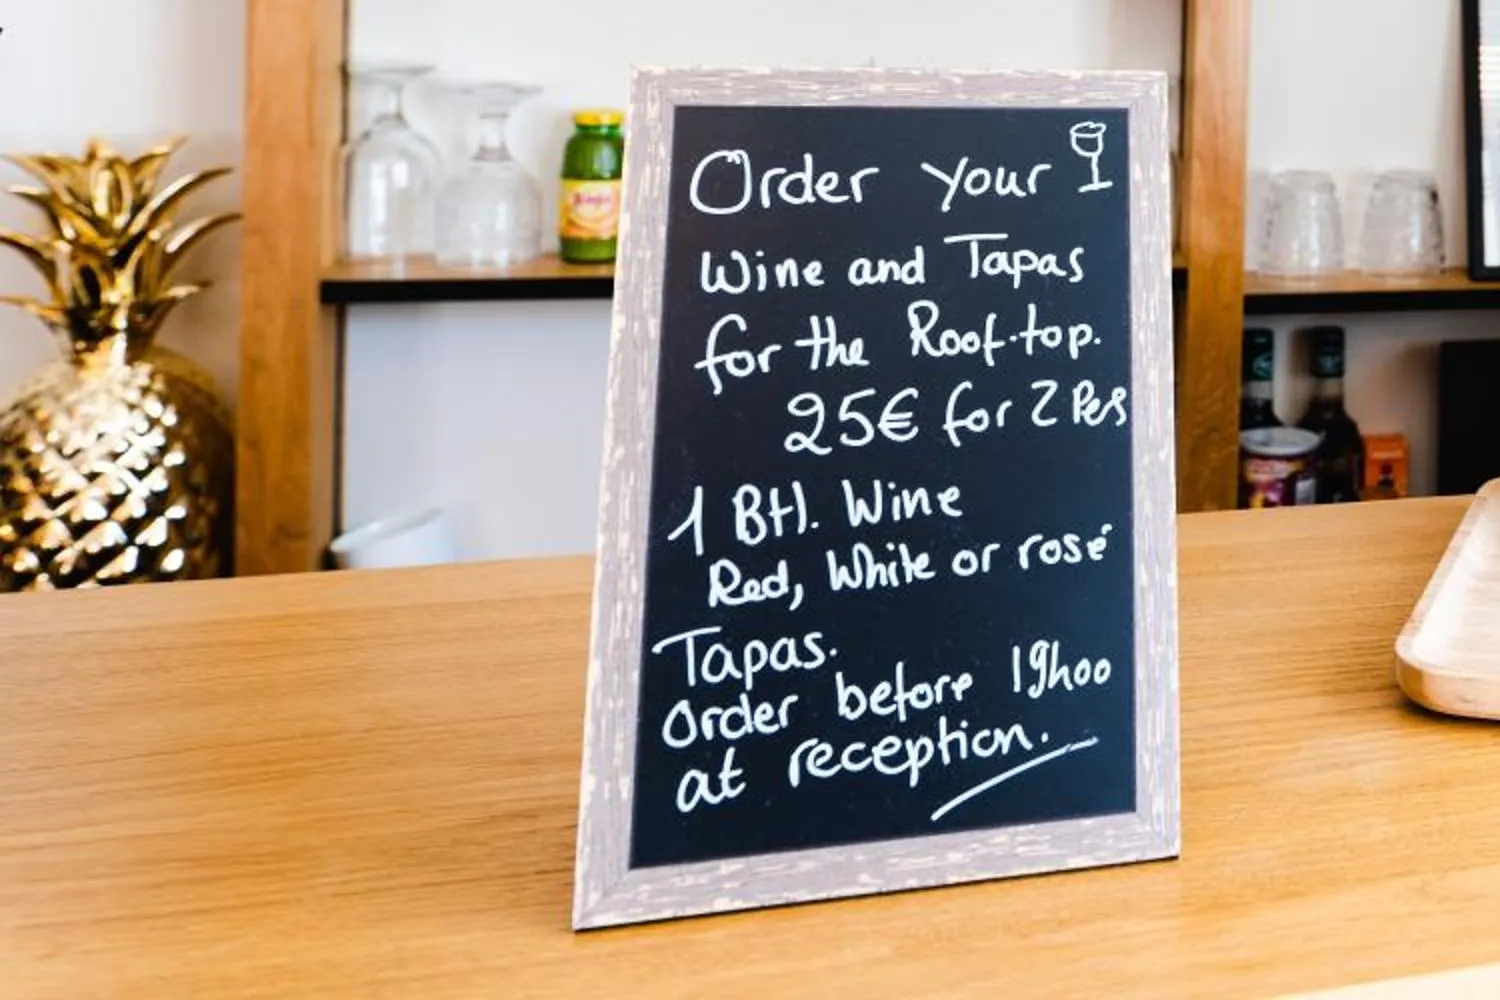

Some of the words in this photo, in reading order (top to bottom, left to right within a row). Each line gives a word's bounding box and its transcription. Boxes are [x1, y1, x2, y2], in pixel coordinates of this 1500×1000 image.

[689, 149, 880, 215] Order
[920, 156, 1052, 213] your
[700, 249, 825, 295] Wine
[847, 245, 926, 287] and
[943, 232, 1085, 289] Tapas
[693, 313, 782, 396] for
[794, 315, 870, 371] the
[783, 387, 919, 456] 25€
[942, 380, 1013, 448] for
[1031, 379, 1059, 427] 2
[667, 485, 704, 556] 1
[841, 479, 963, 527] Wine
[708, 558, 804, 611] Red,
[826, 542, 936, 591] White
[951, 543, 1001, 577] or
[652, 626, 838, 691] Tapas.
[661, 692, 799, 748] Order
[835, 661, 974, 722] before
[1012, 639, 1112, 699] 19h00
[675, 748, 747, 813] at
